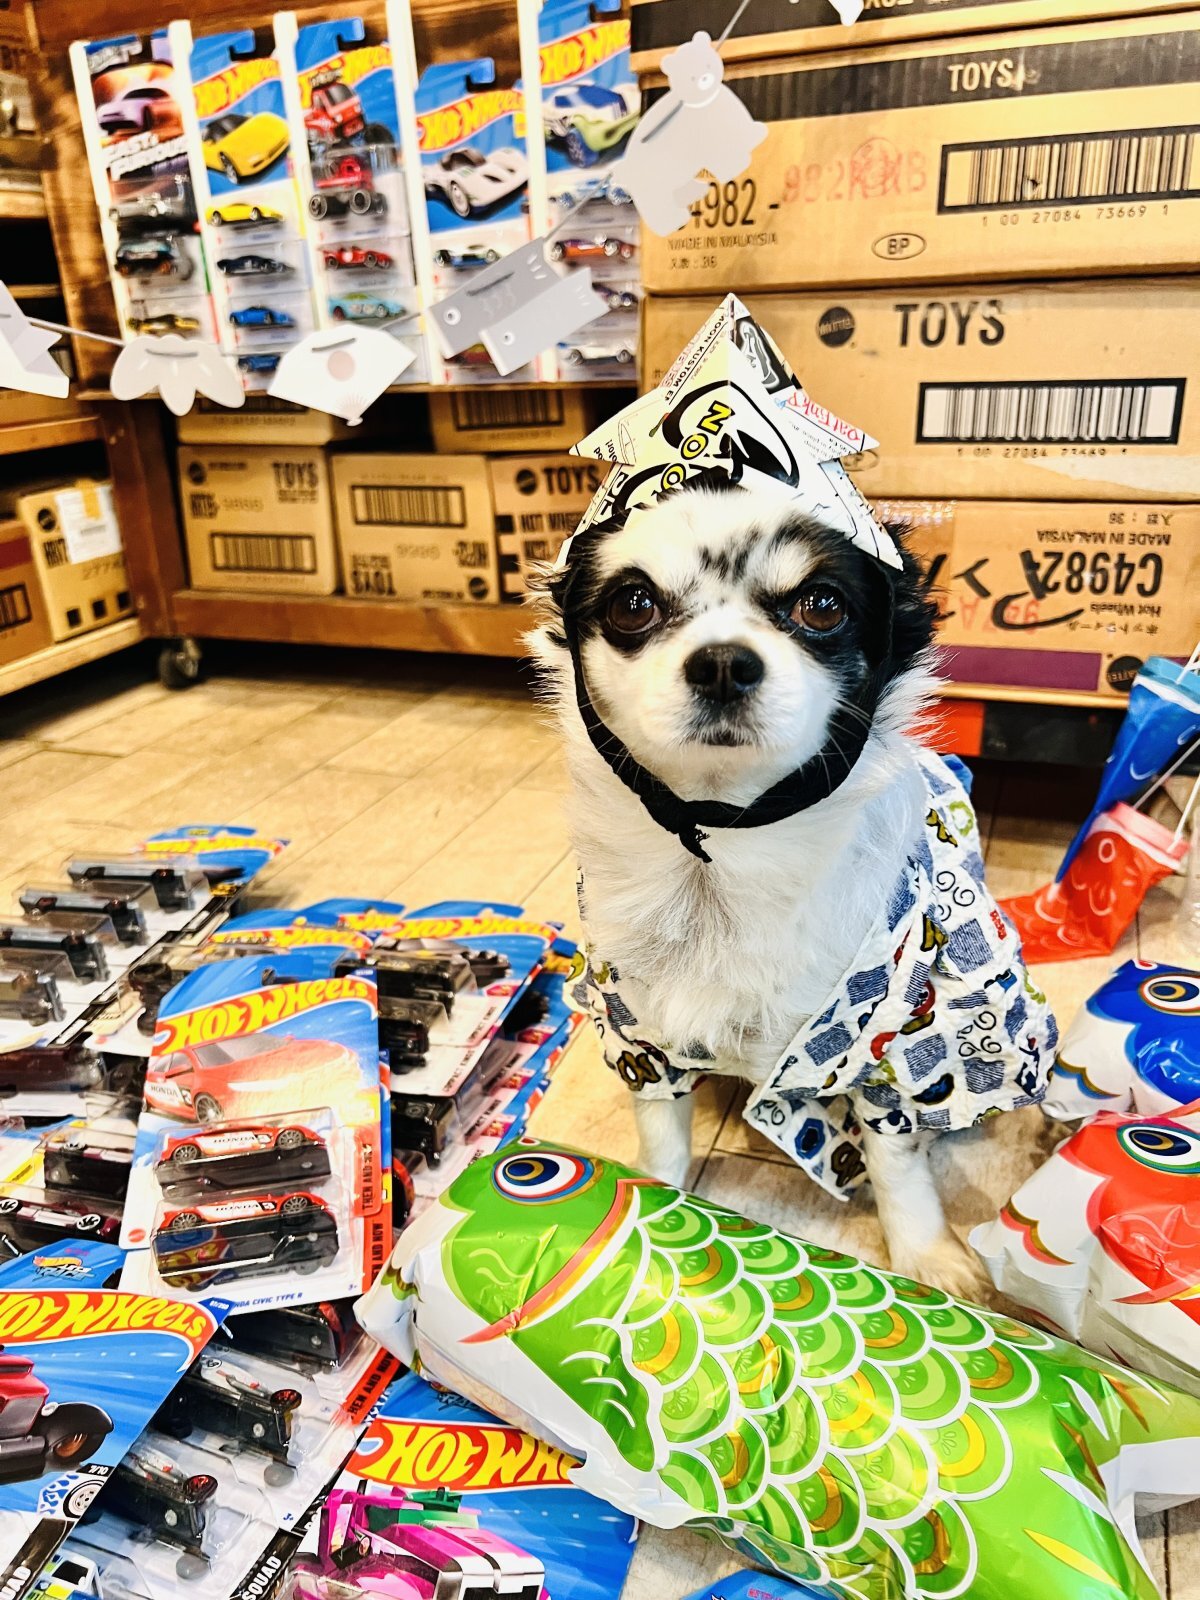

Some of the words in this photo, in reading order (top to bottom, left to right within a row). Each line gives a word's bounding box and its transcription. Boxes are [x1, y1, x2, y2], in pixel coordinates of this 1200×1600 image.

[948, 59, 1014, 92] TOYS
[893, 299, 1005, 347] TOYS
[543, 464, 600, 495] TOYS
[1110, 531, 1125, 545] IN
[1129, 532, 1171, 546] MADE
[242, 1555, 282, 1600] SQUAD
